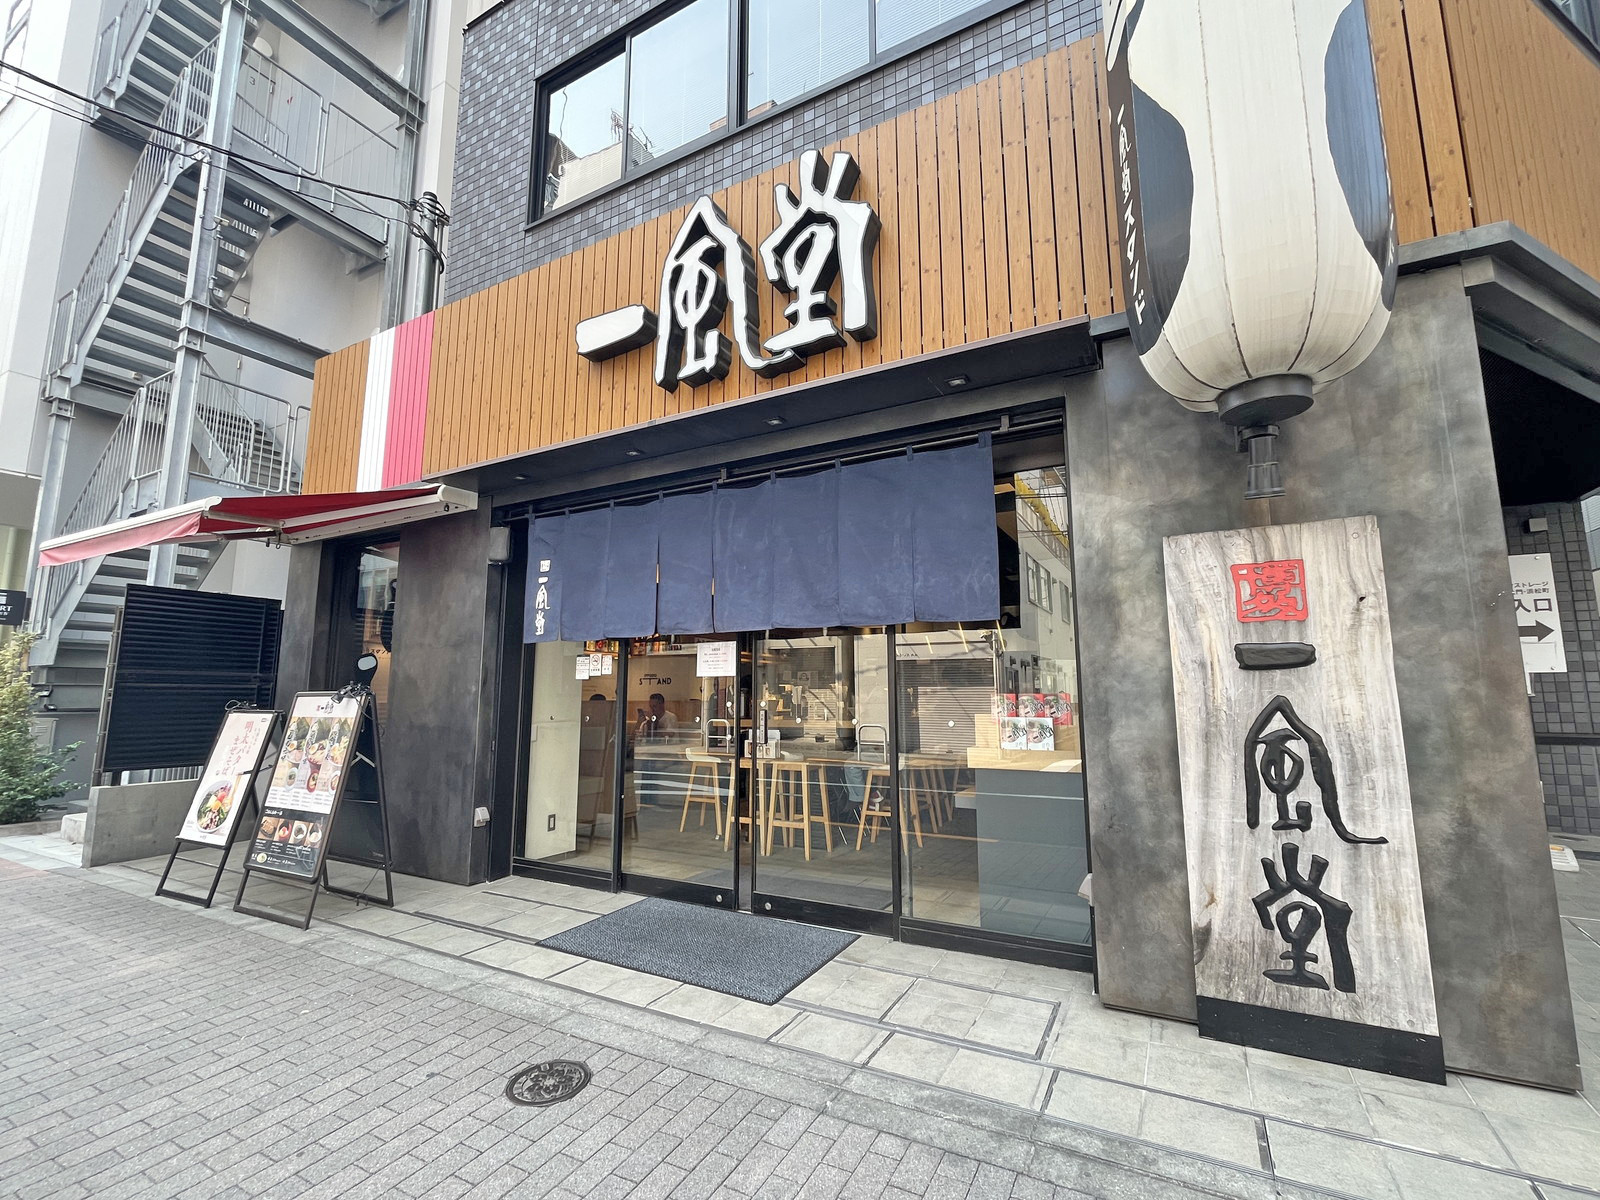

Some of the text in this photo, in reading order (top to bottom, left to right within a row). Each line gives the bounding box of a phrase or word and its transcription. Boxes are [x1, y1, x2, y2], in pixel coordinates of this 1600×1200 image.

[576, 149, 880, 391] 一風堂
[1117, 103, 1146, 326] 一風堂スタンド
[535, 576, 551, 635] 一風堂
[1513, 598, 1552, 612] 入口
[1234, 643, 1389, 994] 一風堂
